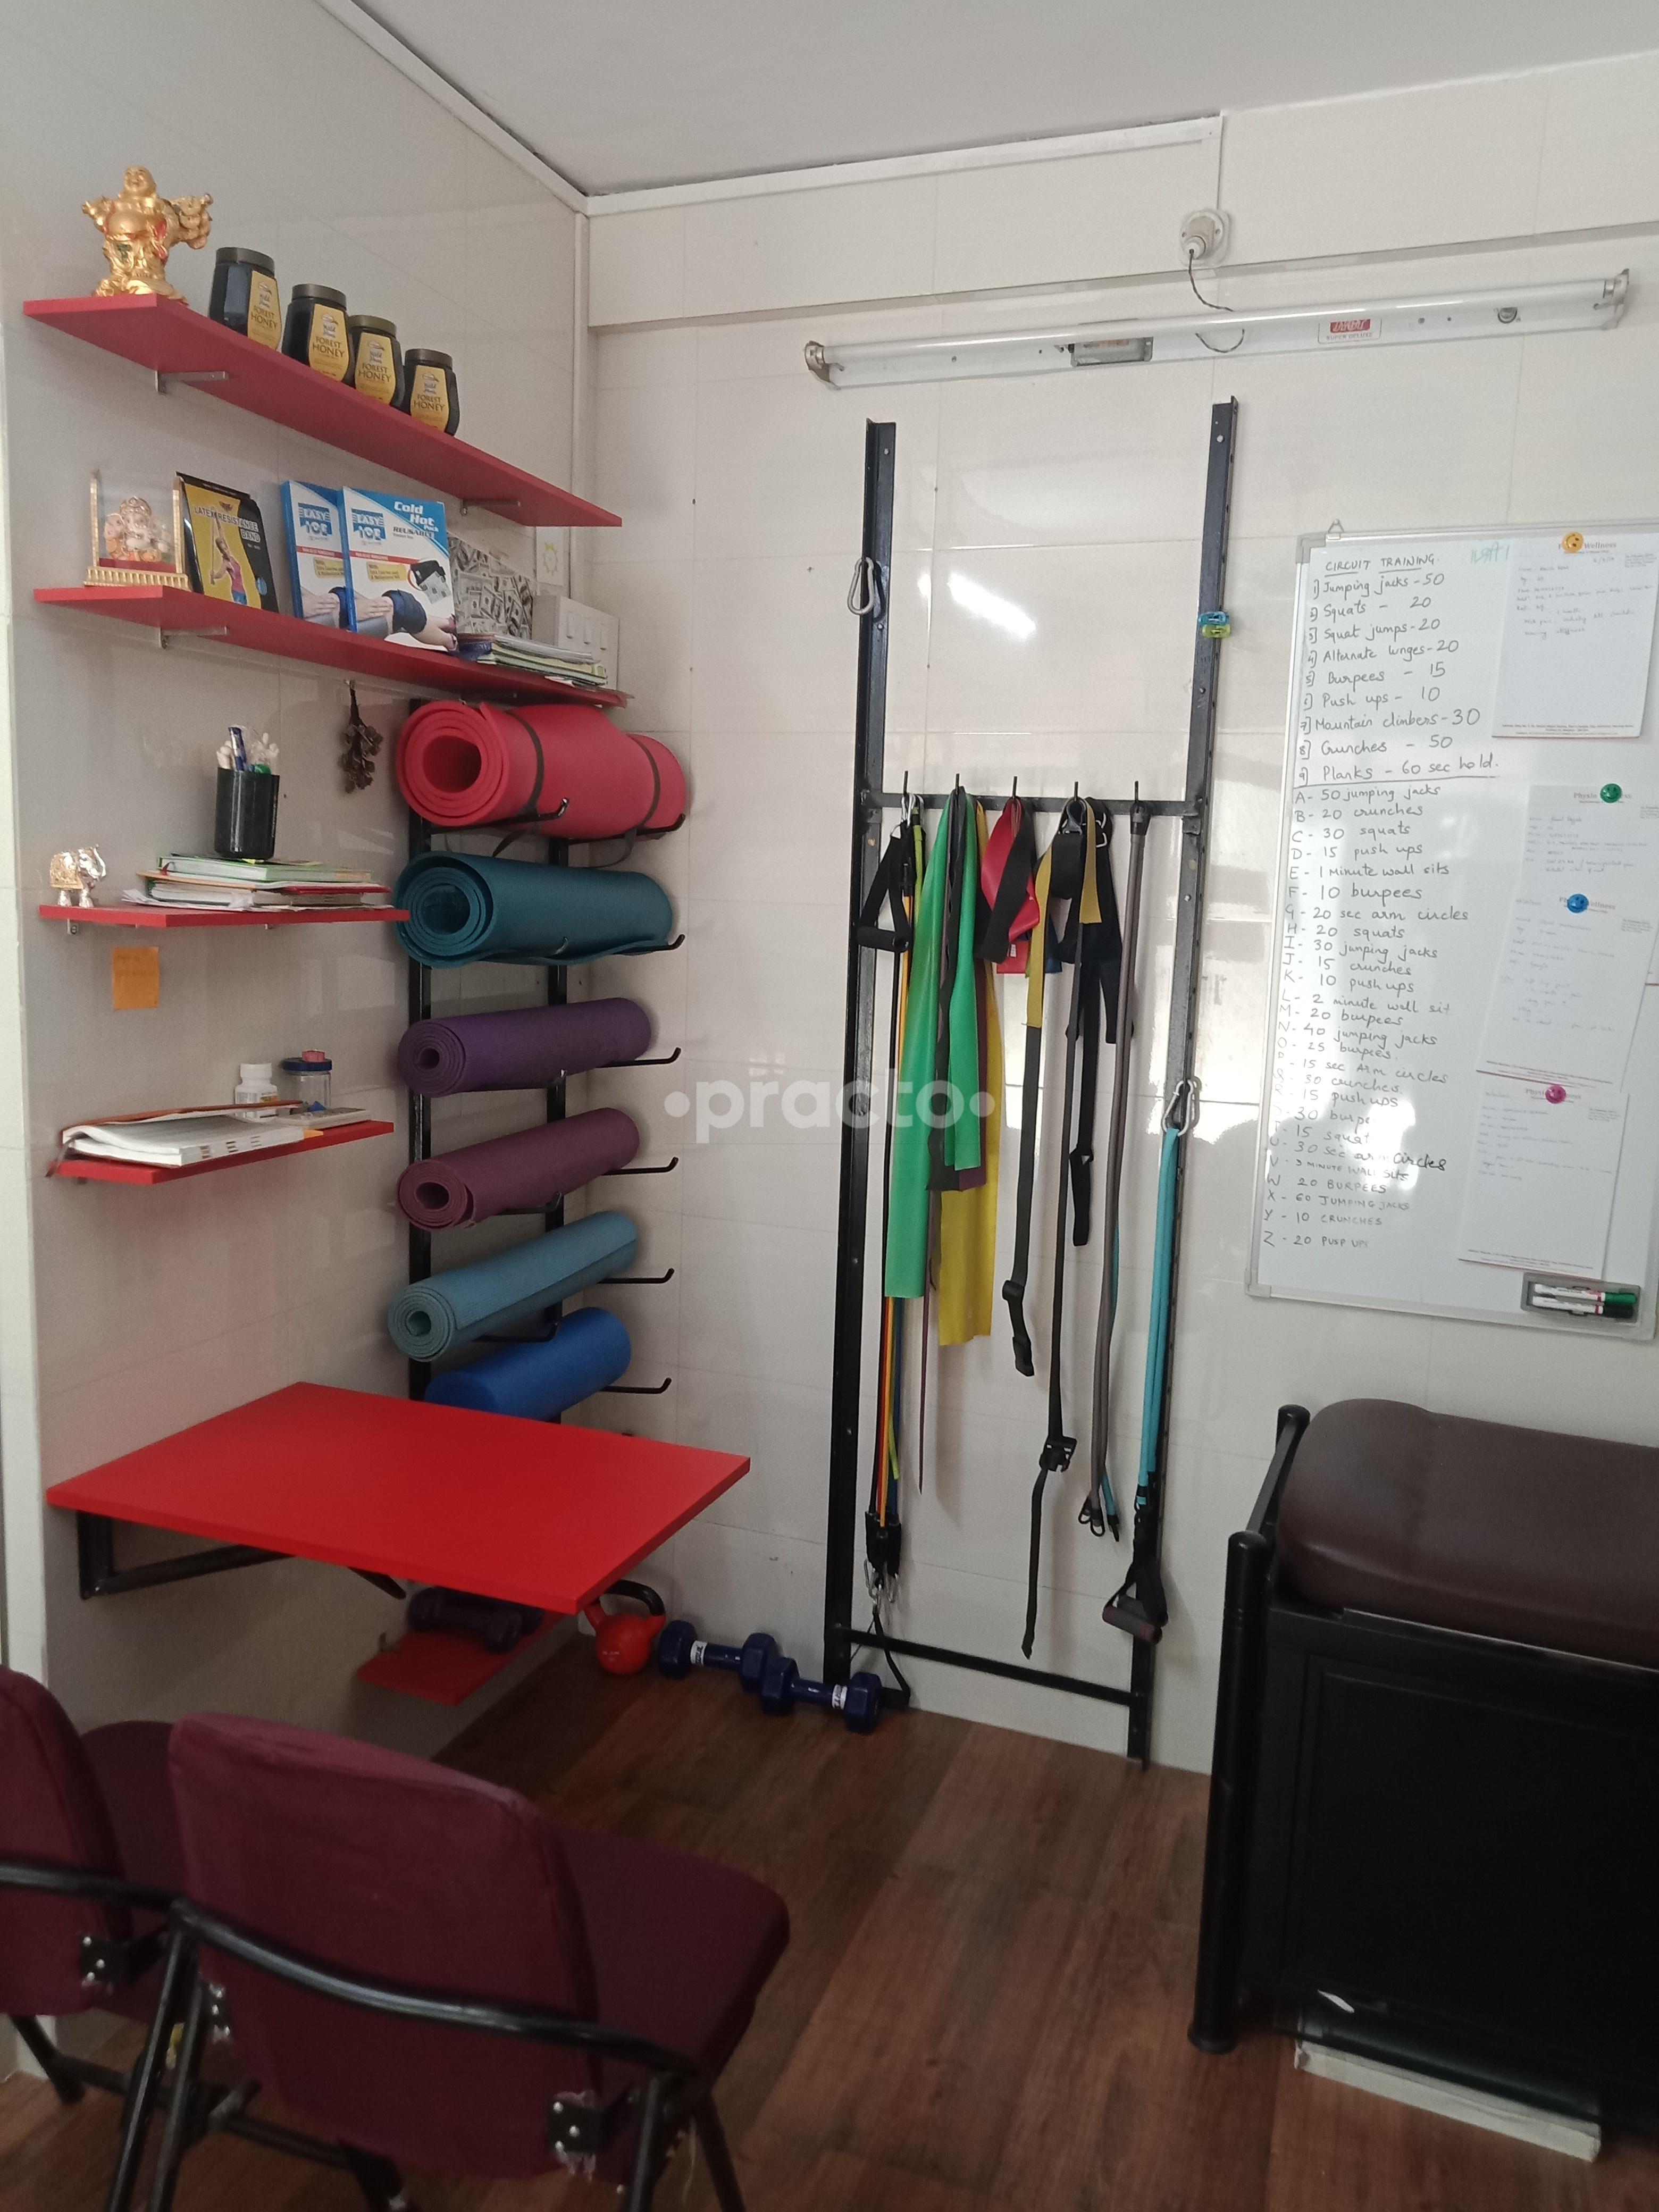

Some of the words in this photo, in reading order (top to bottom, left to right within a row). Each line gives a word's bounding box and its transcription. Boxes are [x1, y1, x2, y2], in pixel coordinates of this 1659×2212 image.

[251, 312, 278, 329] HONEY
[313, 344, 345, 358] HONEY
[316, 336, 342, 349] FOREST
[358, 370, 391, 382] HONEY
[362, 363, 388, 374] FOREST
[414, 401, 445, 412] HONEY
[417, 395, 441, 403] FOREST
[394, 501, 423, 514] Cold
[195, 506, 215, 518] LATEX
[218, 513, 258, 532] RESISTANCE
[409, 514, 434, 527] Hot
[240, 529, 260, 542] BAND
[1325, 560, 1371, 571] CIRCUIT
[1323, 580, 1370, 601] Jumping
[1422, 572, 1444, 585] 50
[1323, 599, 1366, 623] Squats
[1409, 596, 1431, 608] 20
[1324, 624, 1361, 643] Squat
[1323, 648, 1377, 663] Alternate
[1328, 671, 1385, 692] Burpees
[1430, 661, 1445, 677] 15
[1322, 692, 1356, 708] Push
[1365, 693, 1389, 711] ups
[1421, 686, 1440, 701] 10
[1315, 714, 1373, 731] Mountain
[1321, 739, 1387, 755] Crunches
[1429, 734, 1453, 749] 50
[1323, 765, 1373, 781] Planks
[1402, 760, 1421, 775] 60
[1428, 763, 1450, 773] sec
[1321, 789, 1341, 801] 50
[1342, 789, 1395, 804] jumping
[1404, 785, 1441, 800] jacks
[1322, 809, 1342, 820] 20
[1354, 802, 1423, 817] crunches
[1323, 827, 1344, 840] 30
[1360, 820, 1410, 841] squats
[1323, 847, 1338, 858] 15
[1354, 843, 1388, 861] push
[1396, 844, 1423, 861] ups
[1382, 864, 1414, 876] wall
[1424, 862, 1449, 875] sits
[1321, 885, 1340, 900] 10
[1351, 882, 1422, 907] burpees
[1312, 907, 1331, 919] 20
[1340, 910, 1361, 919] sec
[1372, 911, 1405, 921] arm
[1418, 905, 1469, 921] circles
[1317, 924, 1338, 937] 20
[1354, 925, 1405, 941] squats
[1313, 939, 1333, 951] 30
[1339, 941, 1389, 965] jumping
[1397, 944, 1437, 961] jacks
[1319, 956, 1336, 970] 15
[1350, 960, 1411, 975] crunches
[1320, 974, 1337, 986] 10
[1350, 977, 1381, 992] push
[1386, 983, 1414, 998] ups
[1312, 994, 1324, 1004] 2
[1333, 995, 1377, 1010] minute
[1310, 1008, 1330, 1020] 20
[1341, 1011, 1404, 1028] burpees
[1303, 1024, 1325, 1036] 40
[1333, 1029, 1388, 1050] jumping
[1395, 1032, 1438, 1049] jacks
[1308, 1042, 1325, 1052] 25
[1303, 1059, 1317, 1069] 15
[1325, 1062, 1345, 1071] sec
[1395, 1069, 1448, 1084] circles
[1305, 1074, 1322, 1085] 30
[1303, 1089, 1319, 1101] 15
[1331, 1091, 1367, 1107] push
[1370, 1097, 1398, 1108] ups
[1294, 1106, 1318, 1121] 30
[1297, 1124, 1313, 1138] 15
[1294, 1141, 1318, 1153] 30
[1307, 1161, 1342, 1172] MINUTE
[1267, 1174, 1280, 1186] W
[1297, 1178, 1317, 1187] 20
[1327, 1179, 1387, 1194] BURPEES
[1295, 1193, 1311, 1202] 60
[1318, 1195, 1375, 1208] JUMPING
[1378, 1202, 1410, 1210] JACKS
[1296, 1212, 1309, 1223] 10
[1321, 1214, 1382, 1225] CRUNCHES
[1293, 1236, 1311, 1245] 20
